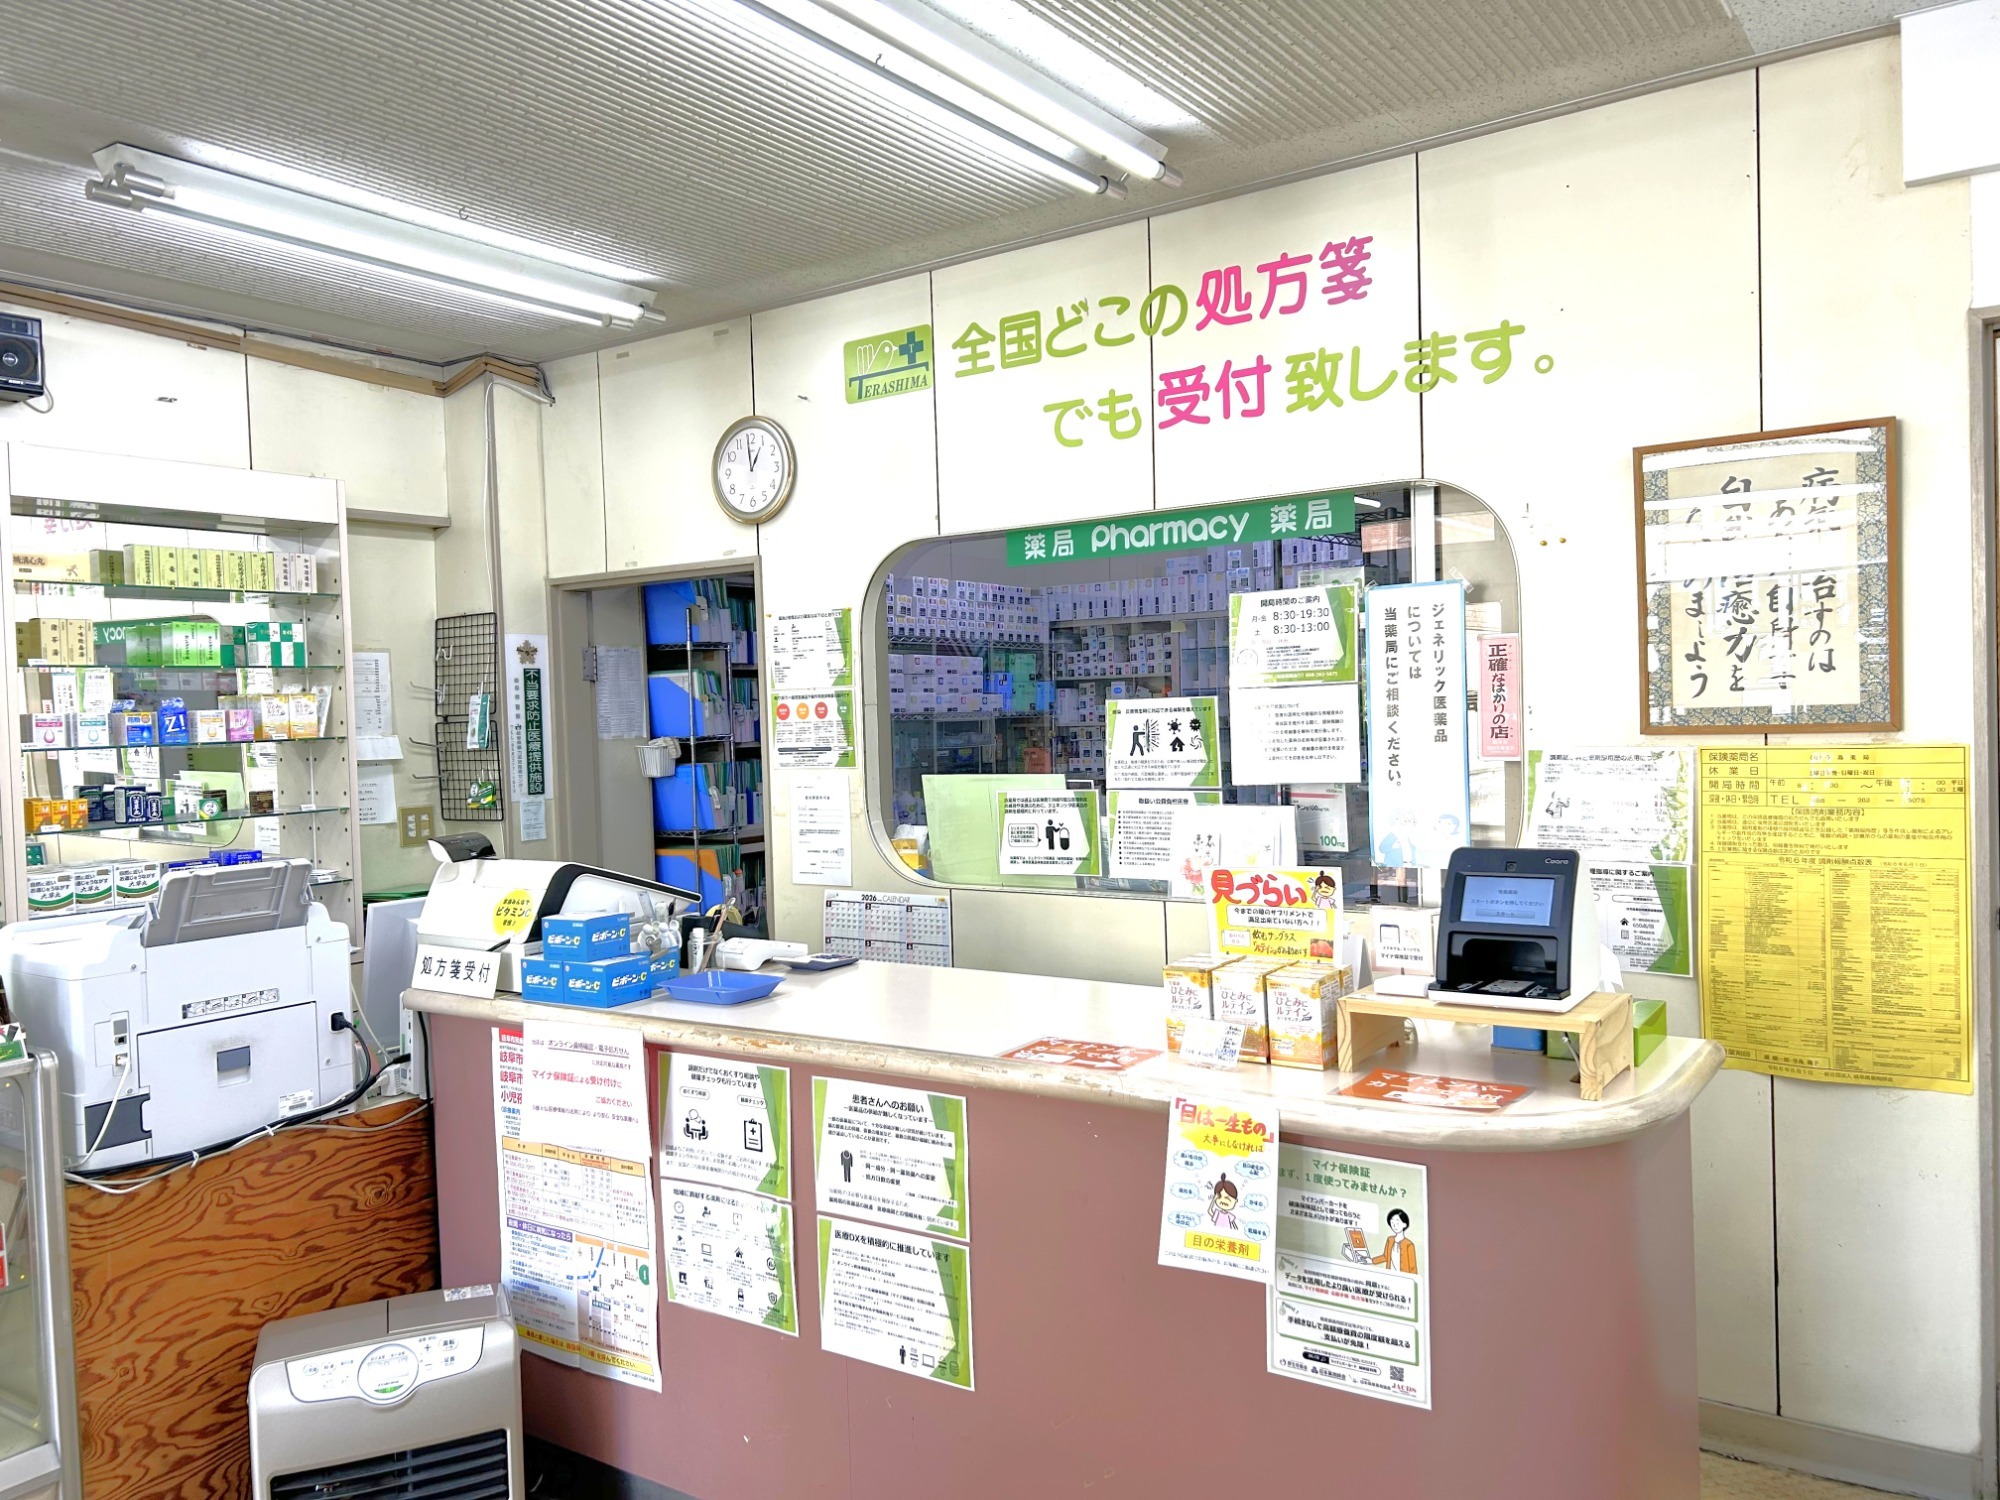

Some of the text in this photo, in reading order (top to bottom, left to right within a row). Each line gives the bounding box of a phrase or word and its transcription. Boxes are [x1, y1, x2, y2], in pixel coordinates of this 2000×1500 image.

[951, 235, 1373, 379] 全国どこの処方箋
[848, 361, 929, 400] TERASHIMA
[770, 445, 776, 456] 2
[728, 451, 736, 463] 10
[774, 461, 780, 472] 3
[724, 468, 732, 480] 9
[730, 484, 736, 494] 8
[770, 479, 776, 490] 4
[740, 494, 744, 504] 7
[750, 496, 756, 508] 6
[762, 491, 768, 502] 5
[1024, 529, 1074, 560] 薬局
[1270, 498, 1332, 535] 薬局
[1260, 596, 1320, 608] 開局時間のご案内
[1272, 608, 1330, 620] 8:30-19:30
[1273, 622, 1330, 634] 8:30-13:00
[1407, 606, 1422, 680] については
[1432, 603, 1448, 742] ジェネリック医薬品
[1384, 607, 1401, 786] 当薬局にご相談ください。
[1488, 644, 1509, 738] 正確なはかりの店
[525, 669, 543, 794] 不当要求防止医療提供施設
[1708, 752, 1758, 762] 保険薬局名
[1708, 780, 1760, 790] 開局時間
[1770, 794, 1800, 805] TEL
[1320, 836, 1346, 848] 100mg
[1211, 869, 1308, 907] 見づらい
[882, 894, 910, 903] CALENDAR
[1470, 898, 1544, 906] スタートボタンを押してください
[496, 906, 531, 918] ビタミンC
[420, 956, 490, 983] 処方箋受付
[1170, 986, 1198, 996] ひとみに
[1221, 990, 1252, 1000] ひとみに
[1171, 996, 1201, 1006] ルテイン
[1222, 1001, 1255, 1010] ルテイン
[1276, 997, 1308, 1008] ひとみに
[1276, 1008, 1310, 1018] ルテイン
[595, 1096, 632, 1108] ご協力ください
[852, 1094, 924, 1114] 患者さんへのお願い
[1312, 1159, 1371, 1178] マイナ保険証
[1300, 1194, 1348, 1210] マイナンバーカードを
[834, 1230, 950, 1262] 医療DXを積極的に推進しています
[1192, 1234, 1250, 1256] 目の栄養剤
